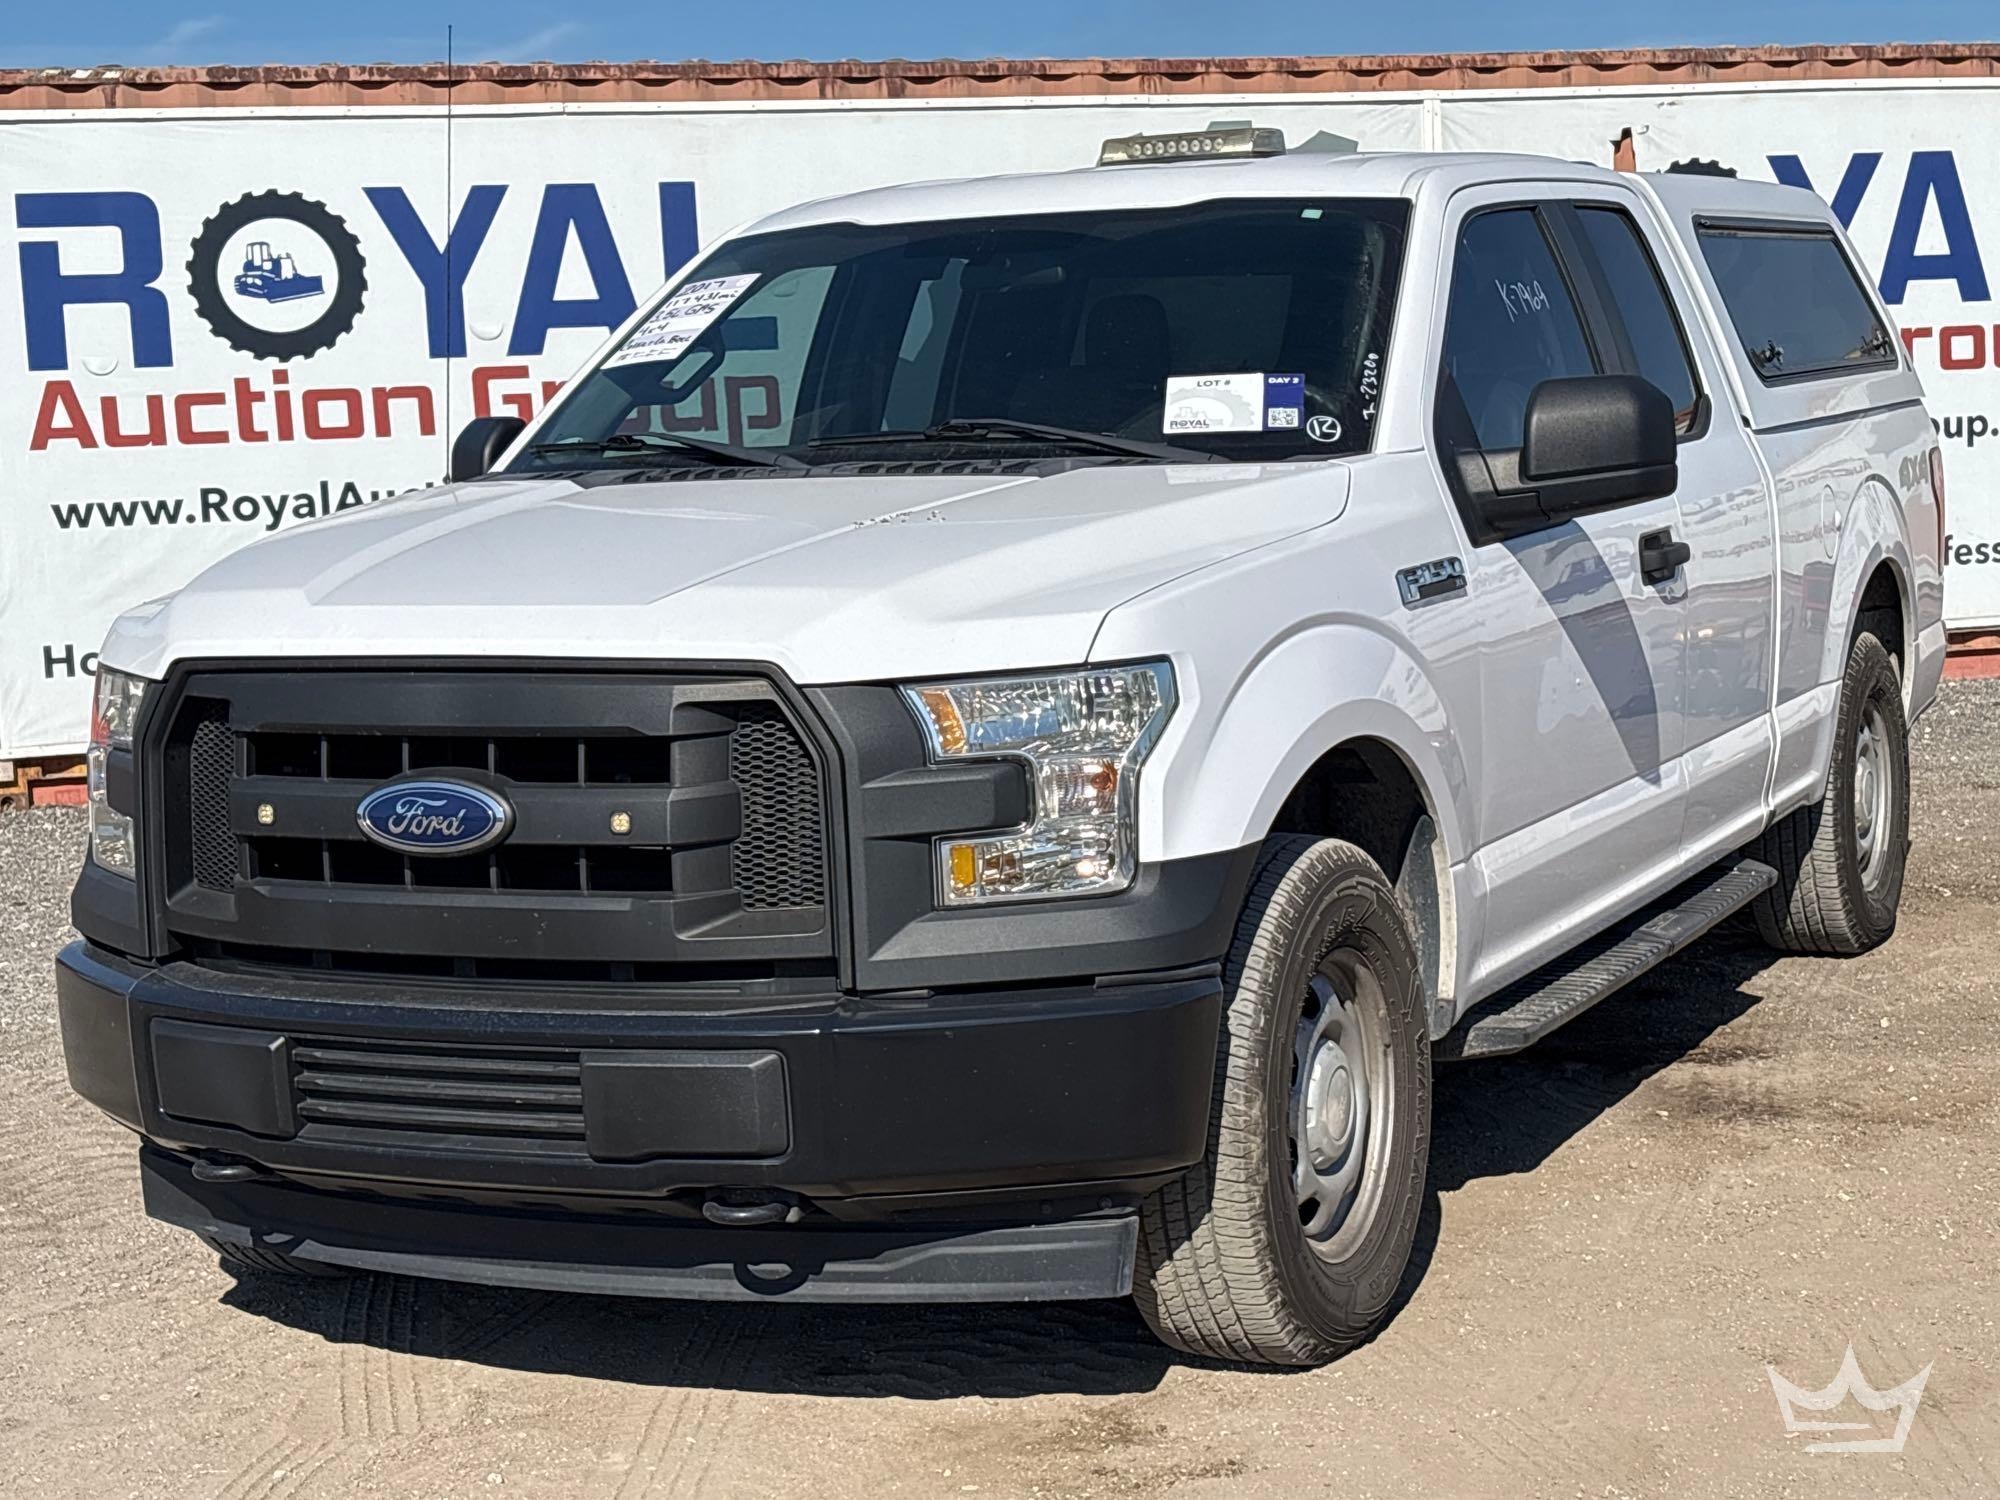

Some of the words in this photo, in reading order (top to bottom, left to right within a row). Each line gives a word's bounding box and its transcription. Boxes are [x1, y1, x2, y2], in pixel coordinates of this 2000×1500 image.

[1664, 151, 1992, 305] YA
[1196, 379, 1222, 388] LOT
[1268, 376, 1291, 384] DAY
[30, 369, 436, 451] Auction
[472, 363, 783, 448] Gup
[1169, 419, 1209, 428] ROYAL
[51, 480, 435, 531] www.RoyalA
[387, 796, 468, 837] Ford
